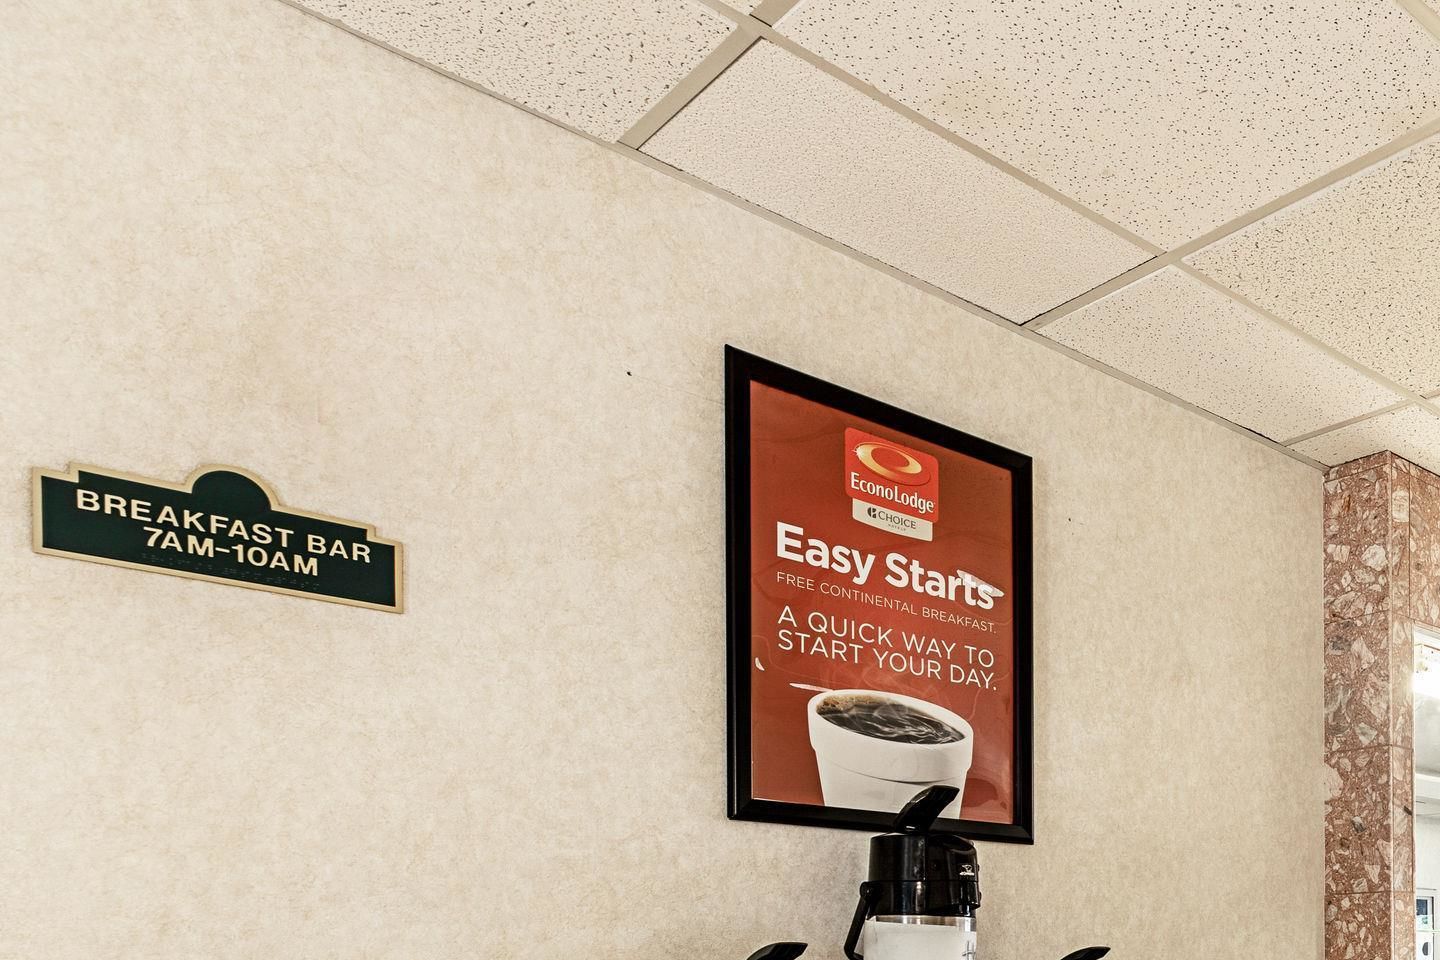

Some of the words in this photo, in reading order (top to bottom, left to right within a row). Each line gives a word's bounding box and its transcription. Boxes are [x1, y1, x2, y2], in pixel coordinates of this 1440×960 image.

[850, 471, 934, 514] EconoLodge
[878, 510, 917, 529] CHOICE
[76, 489, 294, 548] BREAKFAST
[307, 534, 371, 563] BAR
[143, 526, 319, 576] 7AM-10AM
[776, 521, 876, 585] Easy
[884, 552, 995, 609] Starts
[776, 571, 815, 591] FREE
[820, 582, 918, 616] CONTINENTAL
[922, 606, 997, 634] BREAKFAST.
[777, 605, 798, 628] A
[807, 611, 894, 648] QUICK
[901, 631, 957, 660] WAY
[963, 645, 995, 668] TO
[777, 629, 864, 664] START
[873, 648, 942, 680] YOUR
[950, 663, 997, 691] DAY.
